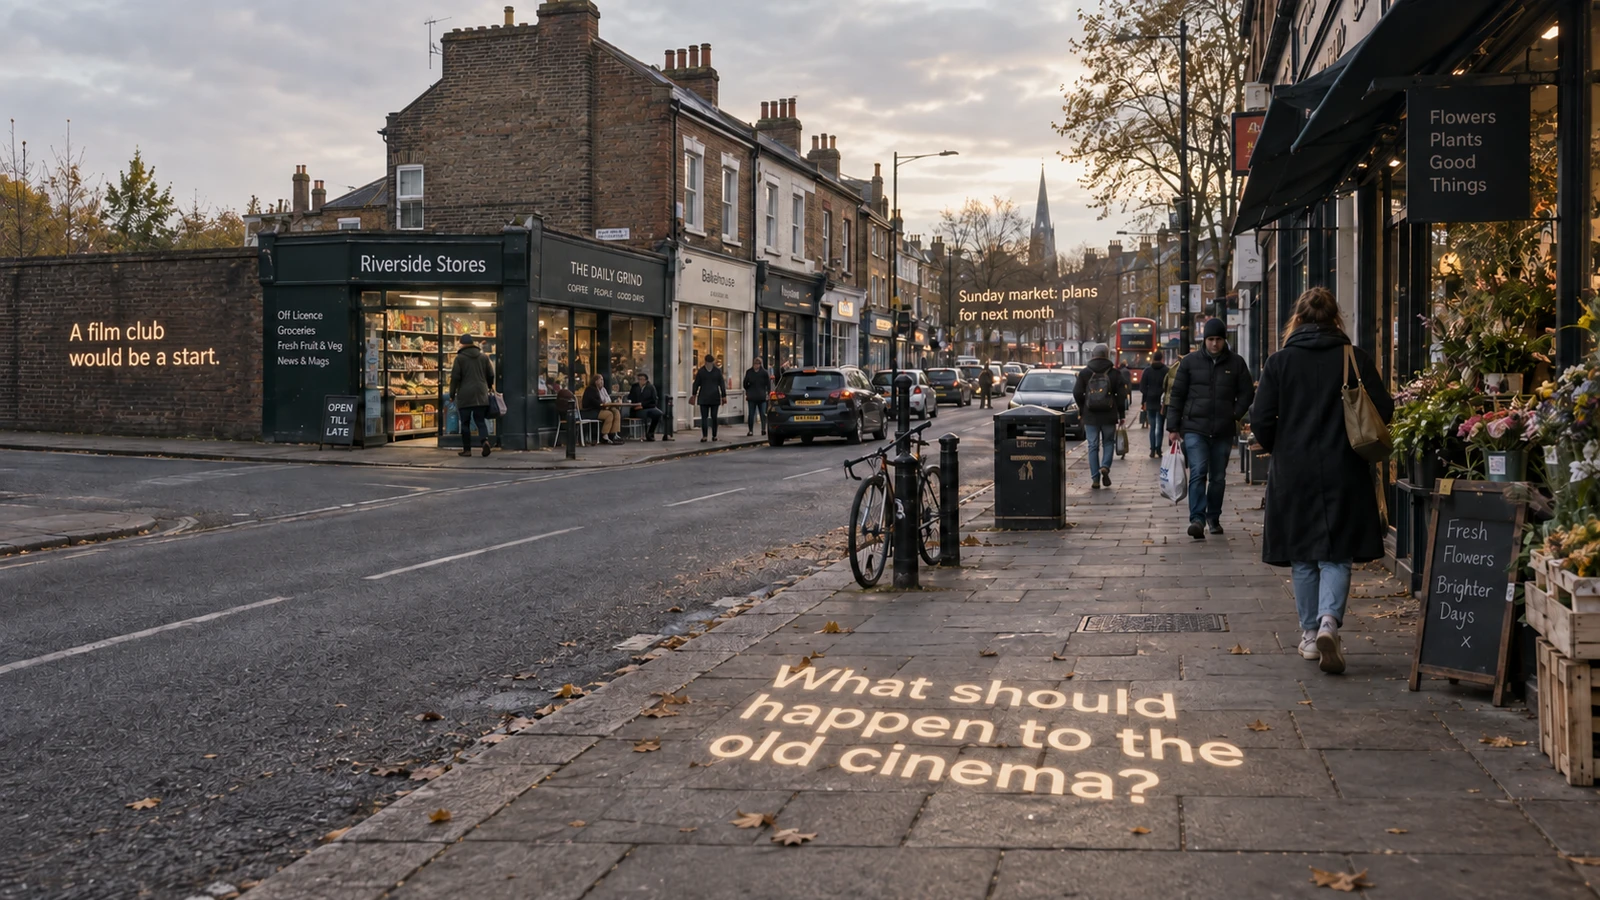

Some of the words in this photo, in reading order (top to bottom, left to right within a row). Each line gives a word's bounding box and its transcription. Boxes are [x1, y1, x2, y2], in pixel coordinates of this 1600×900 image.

[1430, 109, 1497, 125] Flowers
[1430, 132, 1483, 147] Plants
[1429, 154, 1476, 170] Good
[1429, 177, 1487, 196] Things
[361, 254, 432, 273] Riverside
[436, 255, 486, 273] Stores
[571, 261, 589, 277] THE
[591, 265, 615, 282] DAILY
[616, 270, 643, 287] GRIND
[567, 283, 589, 295] COFFEE
[593, 287, 613, 298] PEOPLE
[277, 310, 291, 320] Off
[292, 310, 323, 320] Licence
[69, 322, 83, 342] A
[87, 321, 121, 341] film
[126, 319, 165, 341] club
[277, 325, 316, 336] Groceries
[277, 340, 299, 351] Fresh
[300, 340, 319, 351] Fruit
[319, 341, 326, 351] &
[327, 341, 343, 353] Veg
[69, 347, 122, 367] would
[128, 347, 150, 366] be
[156, 351, 166, 366] a
[172, 347, 220, 365] start.
[277, 356, 299, 366] News
[300, 356, 307, 366] &
[308, 356, 330, 368] Mags
[328, 403, 354, 413] OPEN
[330, 415, 348, 426] TILL
[326, 427, 350, 437] LATE
[1447, 518, 1488, 541] Fresh
[1443, 544, 1495, 567] Flowers
[1435, 574, 1494, 603] Brighter
[1439, 601, 1475, 630] Days
[772, 664, 933, 700] What
[949, 679, 1178, 720] should
[740, 693, 995, 744] happen
[1019, 719, 1092, 751] to
[1116, 728, 1244, 767] the
[709, 731, 827, 767] old
[839, 743, 1160, 804] cinema?
